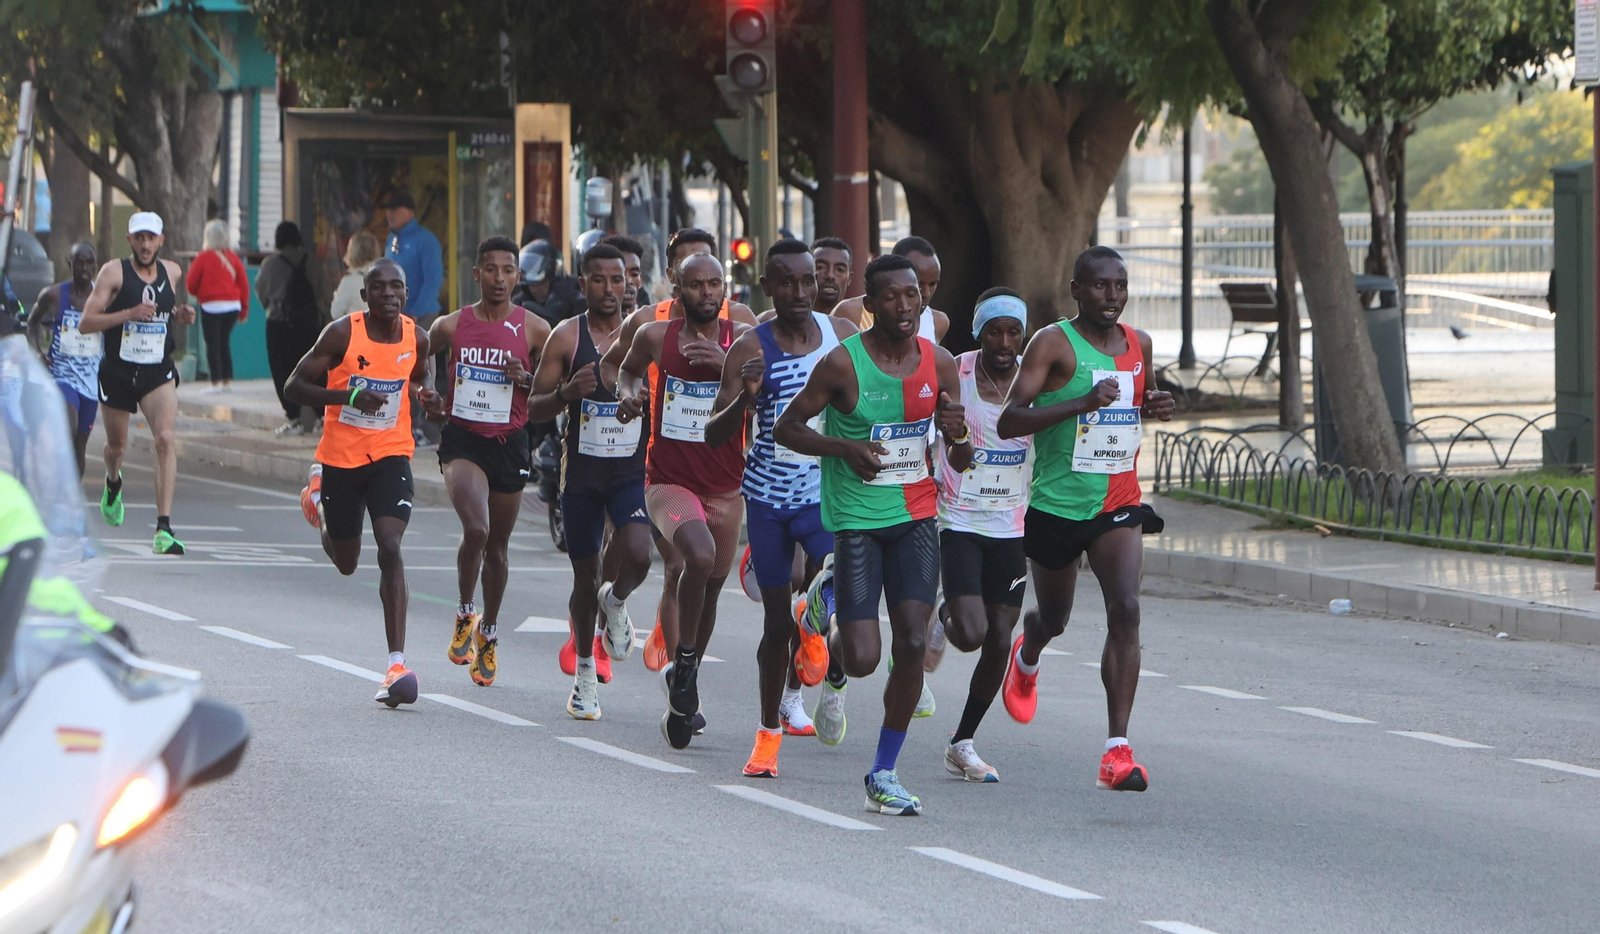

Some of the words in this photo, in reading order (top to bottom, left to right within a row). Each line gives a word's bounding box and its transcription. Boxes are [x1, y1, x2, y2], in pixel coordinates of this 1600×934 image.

[474, 371, 506, 383] ZURICH
[370, 382, 400, 391] ZURICH
[476, 390, 486, 399] 43
[469, 400, 491, 410] FANIEL
[1103, 413, 1136, 422] ZURICH
[600, 427, 624, 435] ZEWDU
[1107, 435, 1118, 445] 36
[898, 448, 910, 457] 37
[991, 454, 1023, 463] ZURICH
[887, 460, 922, 470] HERUIYOT
[996, 474, 1001, 483] 1
[980, 487, 1011, 496] BIRHANU
